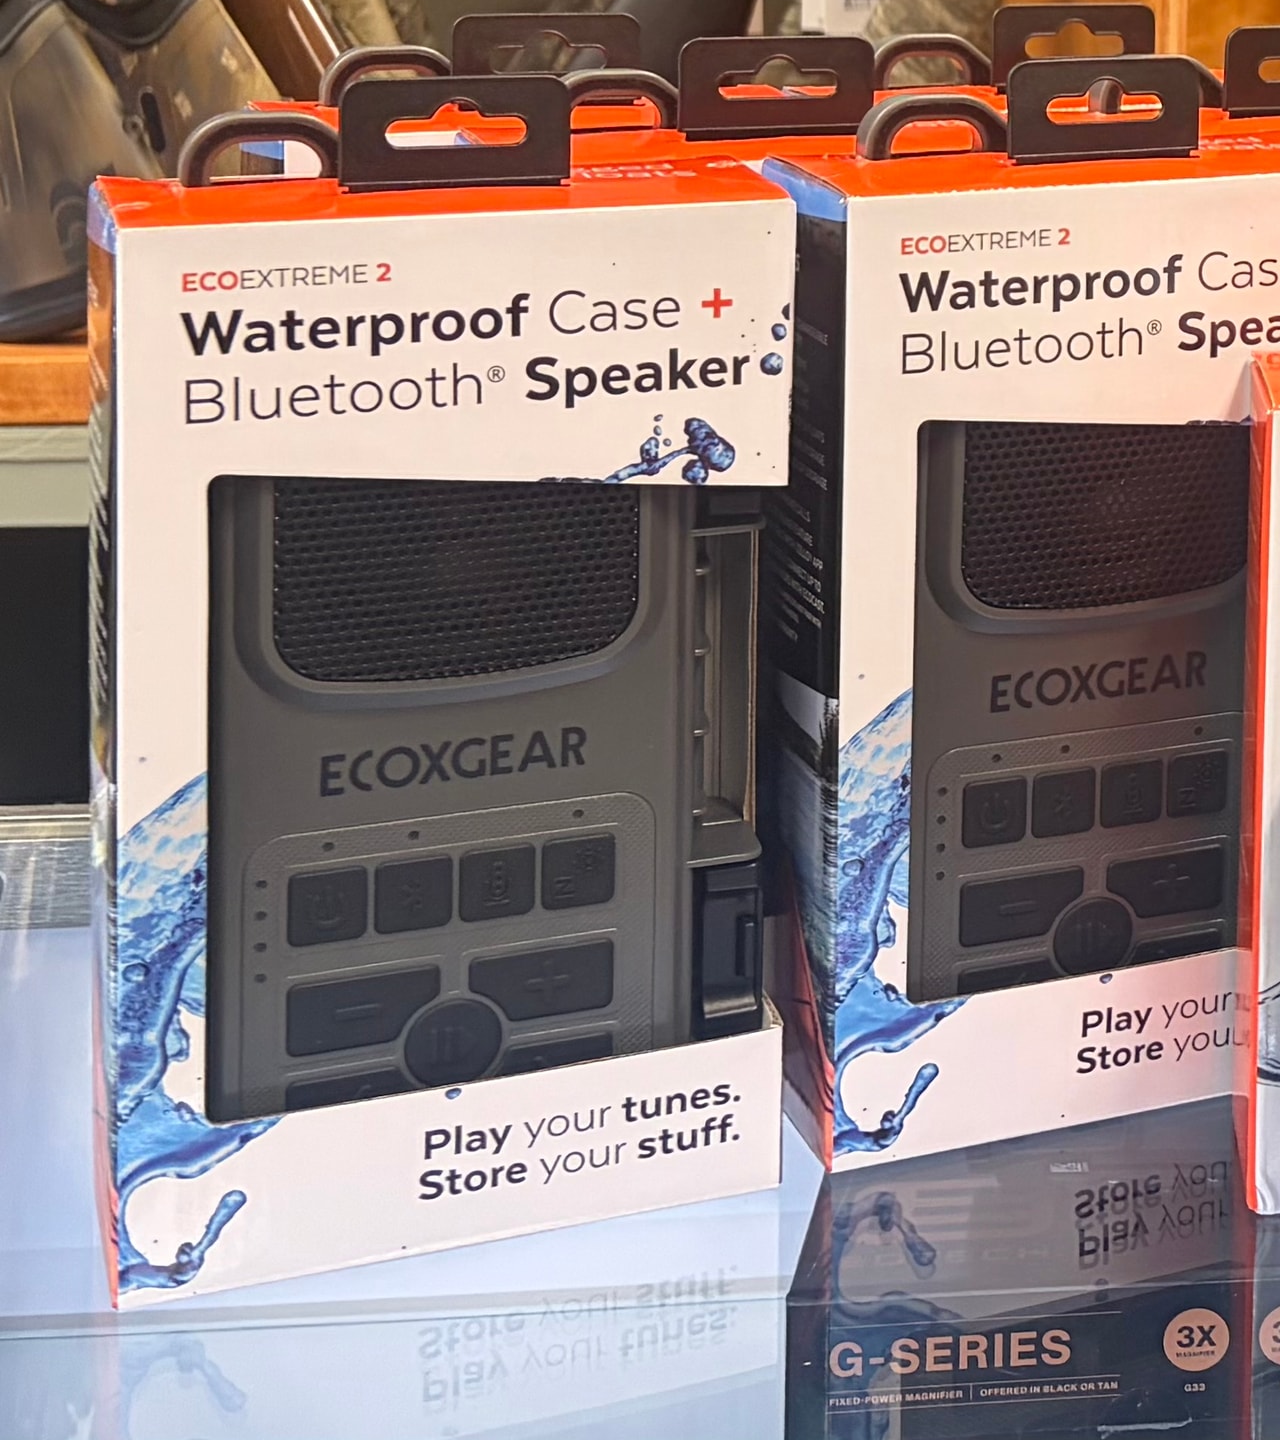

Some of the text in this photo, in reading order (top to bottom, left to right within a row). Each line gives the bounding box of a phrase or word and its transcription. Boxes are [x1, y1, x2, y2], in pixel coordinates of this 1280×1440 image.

[900, 227, 1072, 257] ECOEXTREME 2
[181, 262, 393, 294] ECOEXTREME 2
[898, 253, 1183, 315] Waterproof
[179, 287, 735, 357] Waterproof Case +
[524, 348, 751, 409] Speaker
[989, 650, 1209, 714] ECOXGEAR
[319, 726, 588, 797] ECOXGEAR
[1081, 991, 1233, 1039] Play your
[1075, 1026, 1230, 1075] Store you
[423, 1081, 743, 1160] Play your tunes.
[418, 1114, 742, 1202] Store your stuff.
[828, 1328, 1073, 1378] G-SERIES
[1176, 1325, 1218, 1349] 3X
[828, 1389, 964, 1407] FIXED-POWER MAGNIFIER
[979, 1380, 1119, 1398] OFFERED IN BLACK OR TAN
